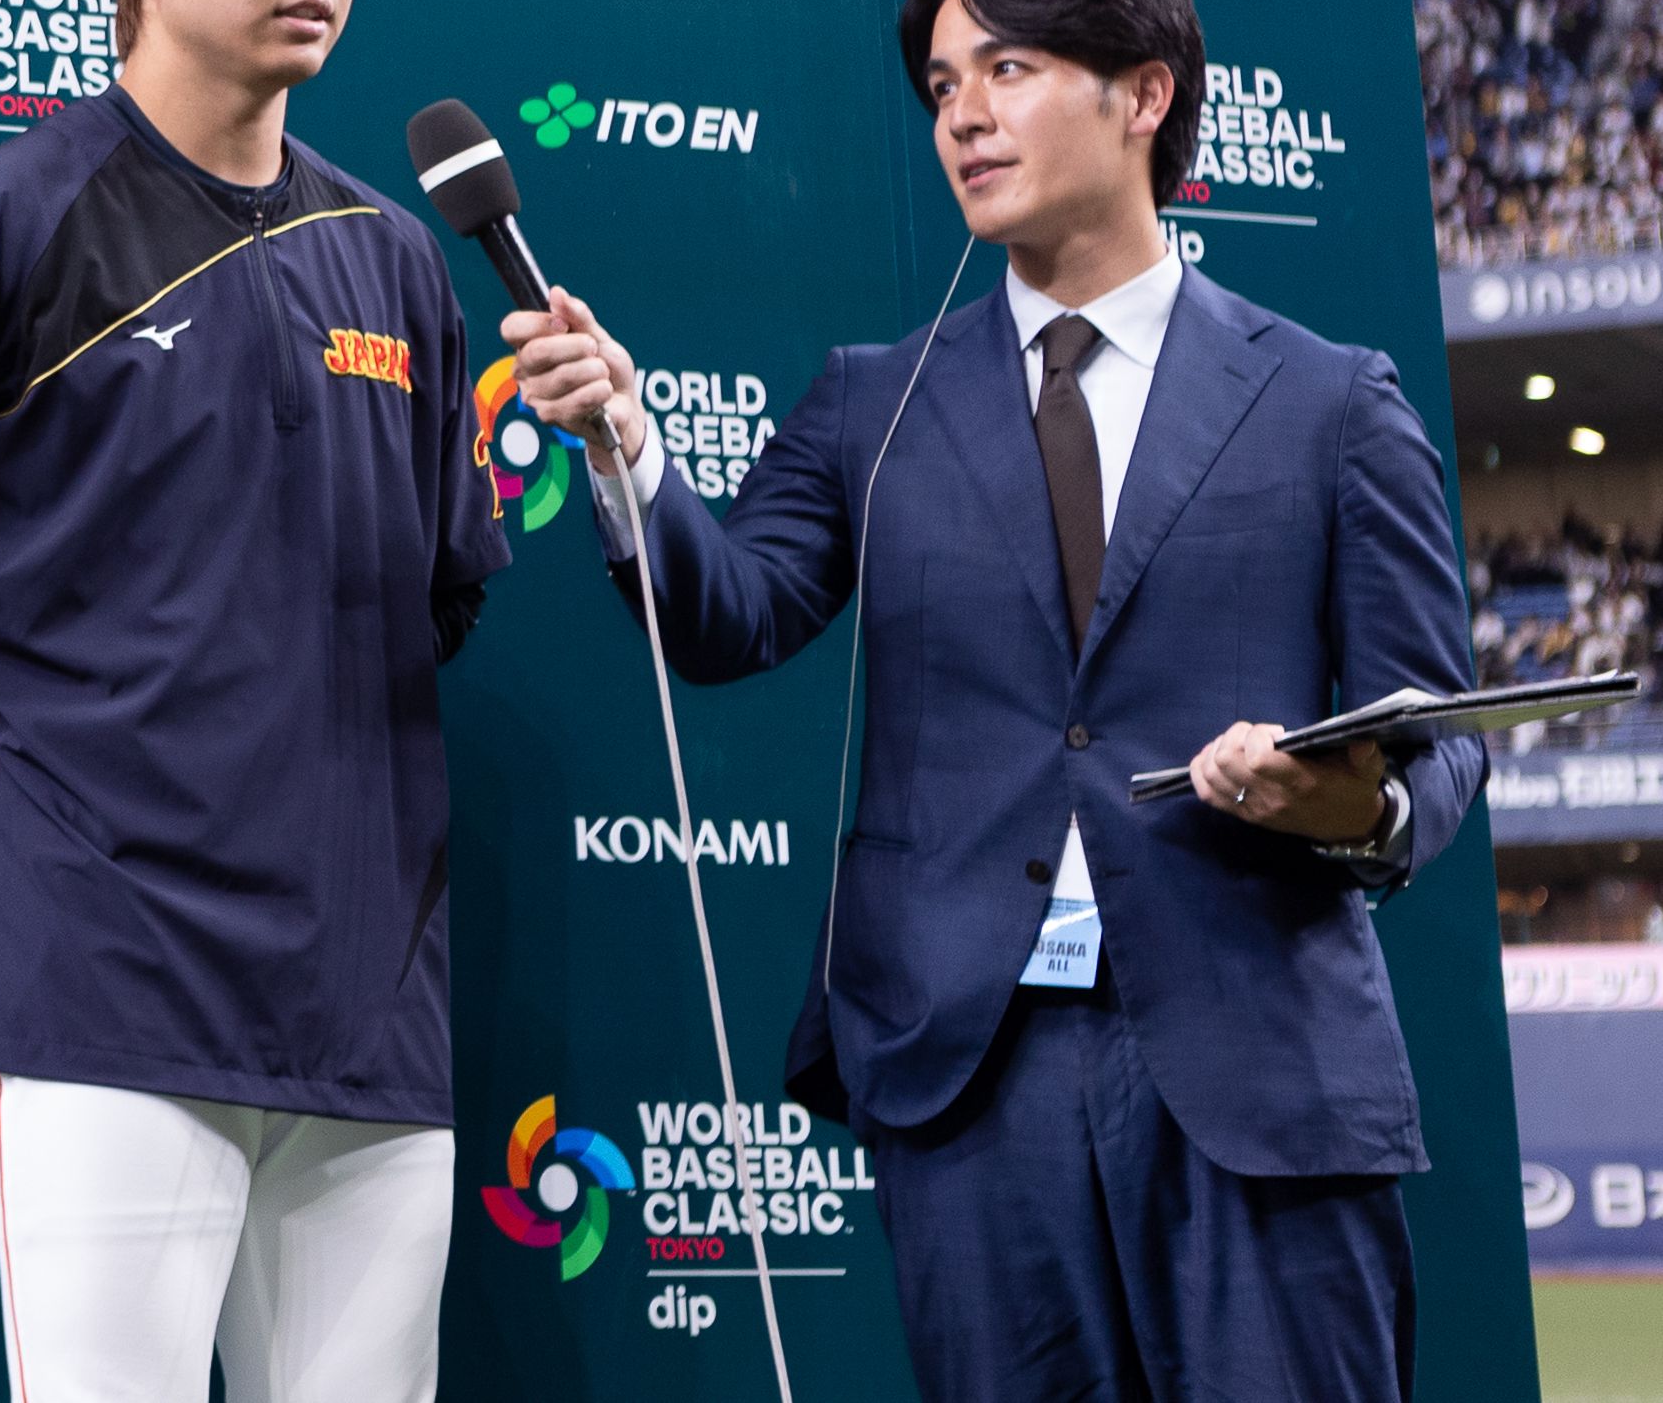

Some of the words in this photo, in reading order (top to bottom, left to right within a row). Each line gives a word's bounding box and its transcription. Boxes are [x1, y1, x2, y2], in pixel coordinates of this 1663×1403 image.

[1185, 143, 1315, 190] ASSIC
[1177, 180, 1210, 205] YO
[324, 328, 412, 394] JAPAN
[635, 369, 767, 416] ORLD
[646, 411, 776, 458] SEBA
[574, 815, 790, 866] KONAMI
[637, 1102, 811, 1146] WORLD
[642, 1146, 875, 1190] BASEBALL
[642, 1191, 844, 1236] CLASSIC
[646, 1237, 725, 1261] TOKYO
[647, 1284, 717, 1337] dip
